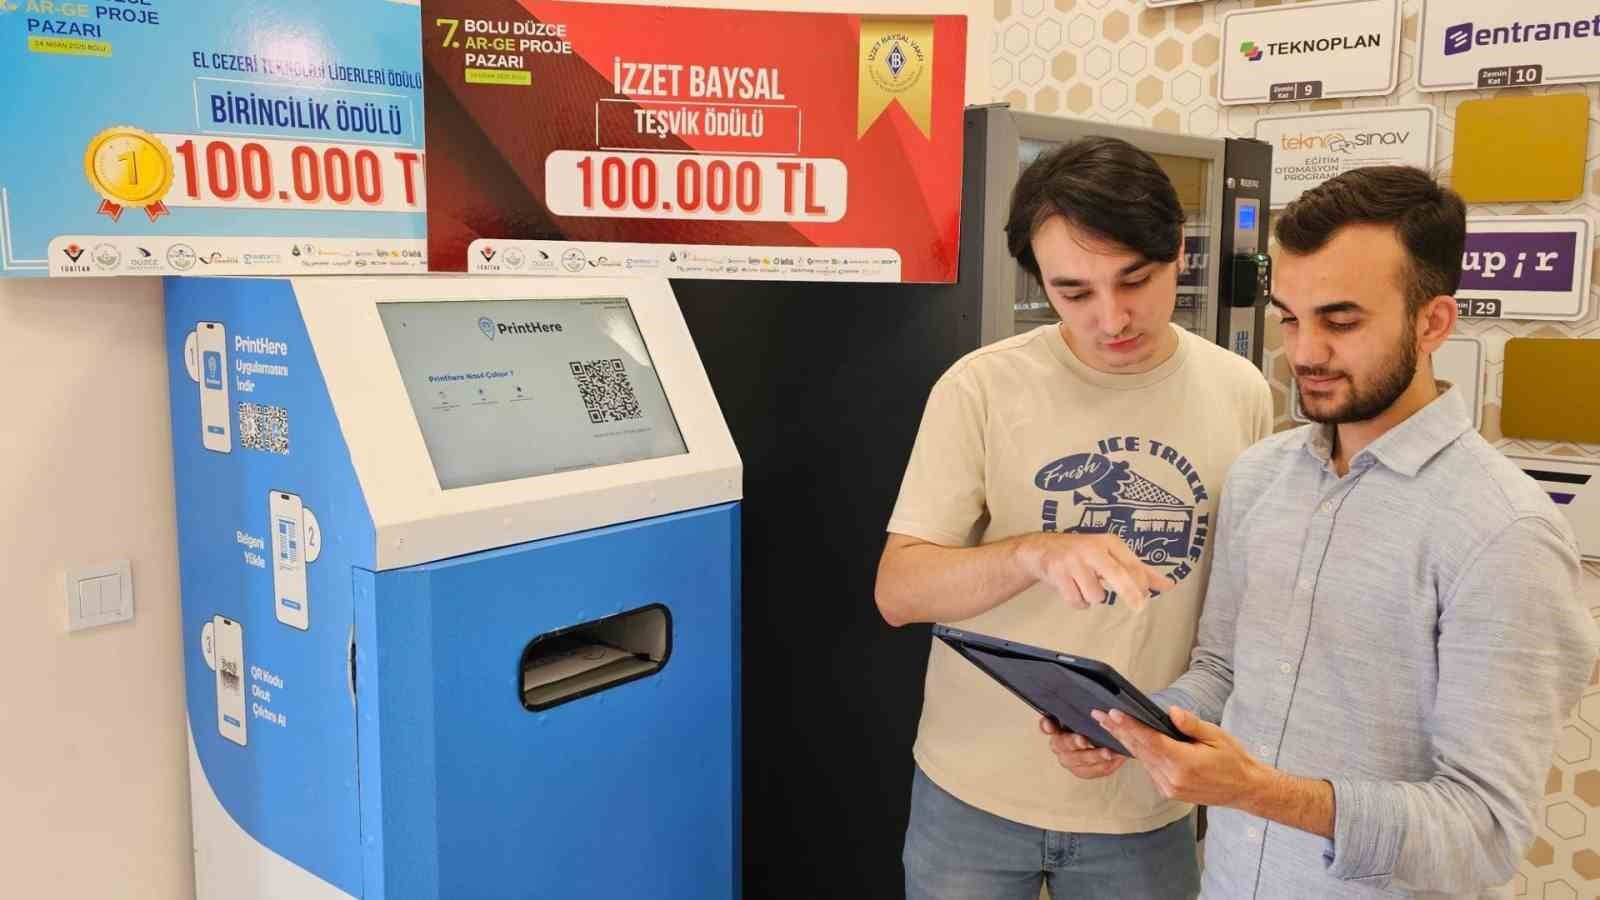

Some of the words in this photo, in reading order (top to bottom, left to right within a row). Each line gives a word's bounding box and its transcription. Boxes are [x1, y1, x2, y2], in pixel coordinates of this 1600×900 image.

[95, 5, 160, 25] PROJE
[27, 18, 102, 38] PAZARI
[436, 18, 460, 48] 7.
[464, 19, 510, 35] BOLU
[513, 20, 567, 38] DÜZCE
[1475, 14, 1600, 46] entranet
[465, 36, 516, 52] AR-GE
[519, 38, 573, 55] PROJE
[1267, 33, 1381, 56] TEKNOPLAN
[192, 51, 210, 68] EL
[212, 53, 258, 73] CEZERİ
[328, 62, 386, 86] LİDERLERİ
[388, 70, 423, 89] ÖDÜLÜ
[464, 53, 524, 70] PAZARI
[613, 56, 683, 96] İZZET
[689, 65, 785, 101] BAYSAL
[1515, 69, 1537, 83] 10
[1304, 84, 1313, 96] 9
[210, 90, 331, 131] BİRİNCİLİK
[335, 100, 402, 136] ÖDÜLÜ
[634, 107, 701, 138] TEŞVİK
[704, 107, 765, 138] ÖDÜLÜ
[176, 139, 384, 206] 100.000
[394, 151, 426, 206] T
[576, 155, 762, 215] 100.000
[776, 161, 828, 217] TL
[1475, 302, 1496, 315] 29
[497, 321, 563, 335] PrintHere
[1098, 436, 1140, 455] ICE
